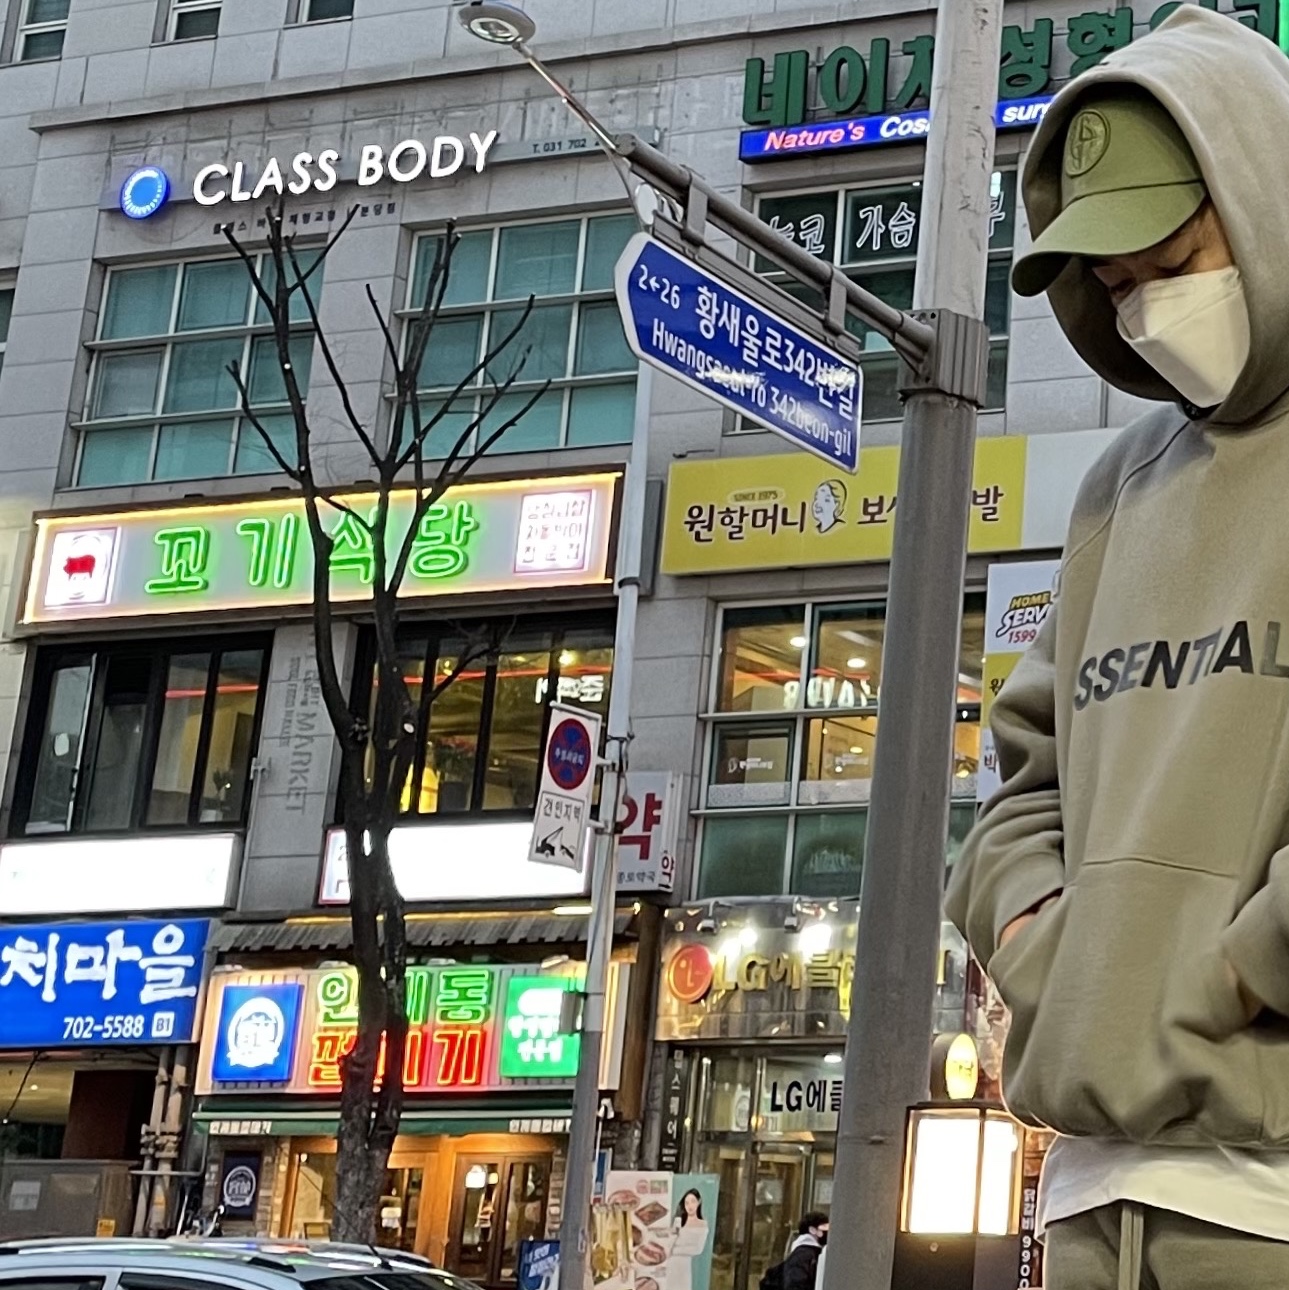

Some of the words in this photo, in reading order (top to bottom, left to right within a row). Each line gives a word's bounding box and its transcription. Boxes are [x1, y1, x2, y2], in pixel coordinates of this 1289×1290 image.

[764, 122, 865, 151] Nature's
[193, 149, 340, 205] CLASS
[358, 131, 498, 185] BODY
[856, 201, 916, 252] 가슴
[660, 277, 680, 310] 26
[683, 501, 807, 543] 원할머니
[144, 500, 475, 594] 꼬기식당
[1011, 590, 1051, 609] HOME
[1007, 629, 1037, 644] 1599
[615, 792, 663, 861] 약
[0, 923, 197, 1005] 치마을
[62, 1014, 145, 1040] 702-5588
[154, 1014, 173, 1038] B1
